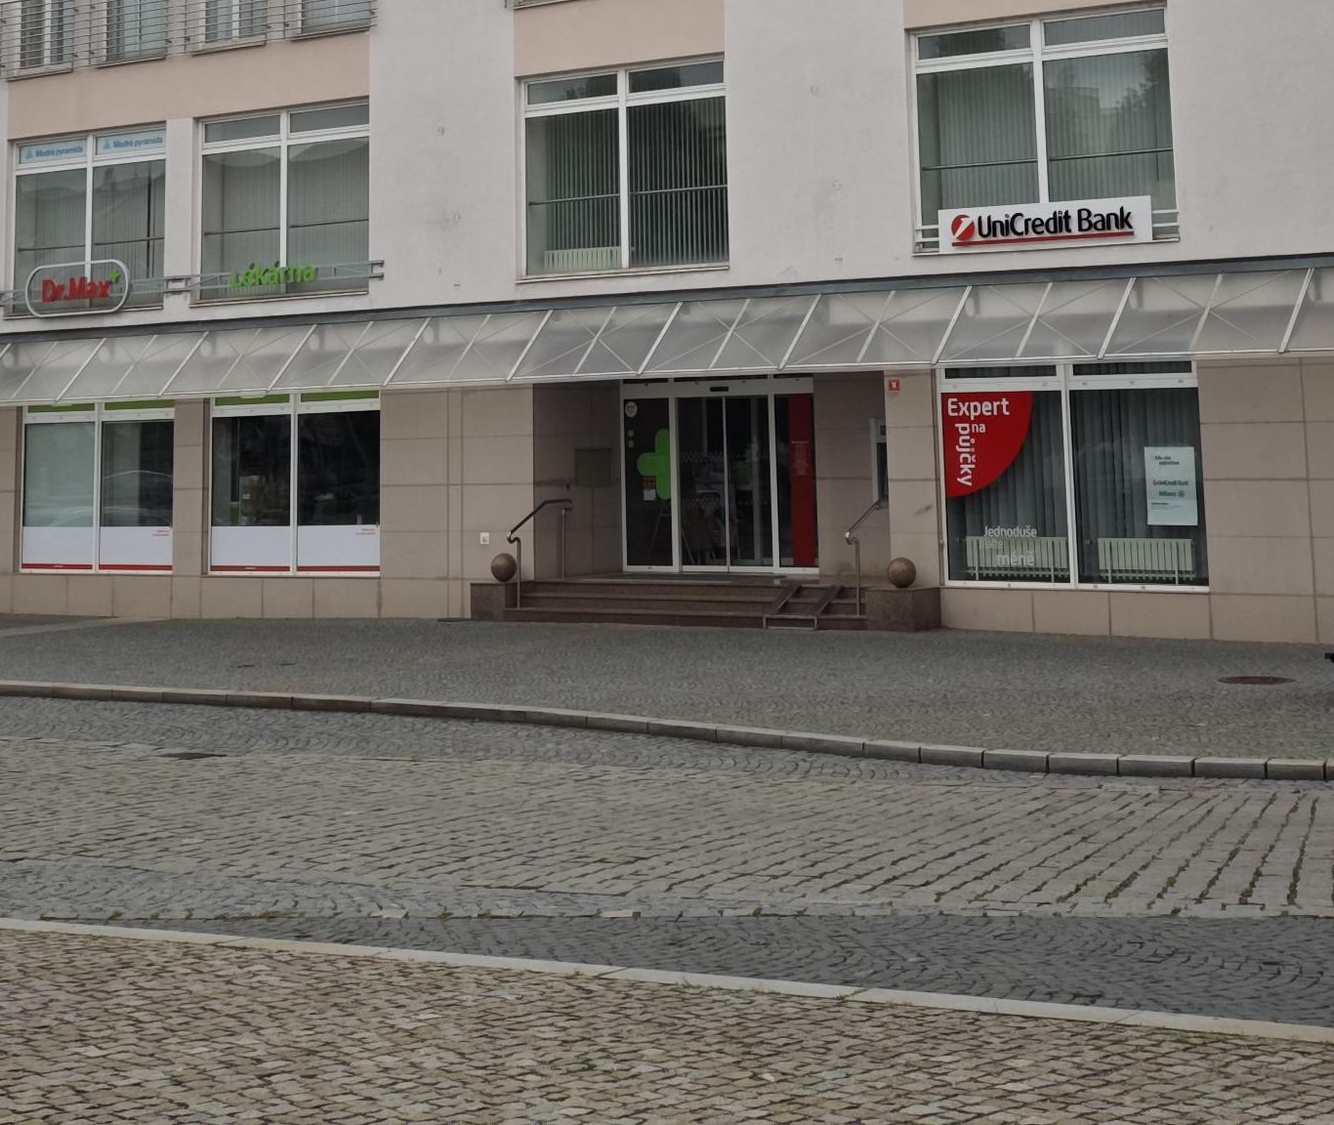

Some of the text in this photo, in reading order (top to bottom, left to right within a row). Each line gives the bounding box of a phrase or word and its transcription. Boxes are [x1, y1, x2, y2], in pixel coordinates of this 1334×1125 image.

[977, 206, 1134, 238] UniCredit Bank
[231, 260, 316, 288] Lékárna
[948, 397, 1010, 420] Expert
[971, 423, 986, 434] na
[955, 423, 976, 486] půjčky
[984, 525, 1038, 537] Jednoduše
